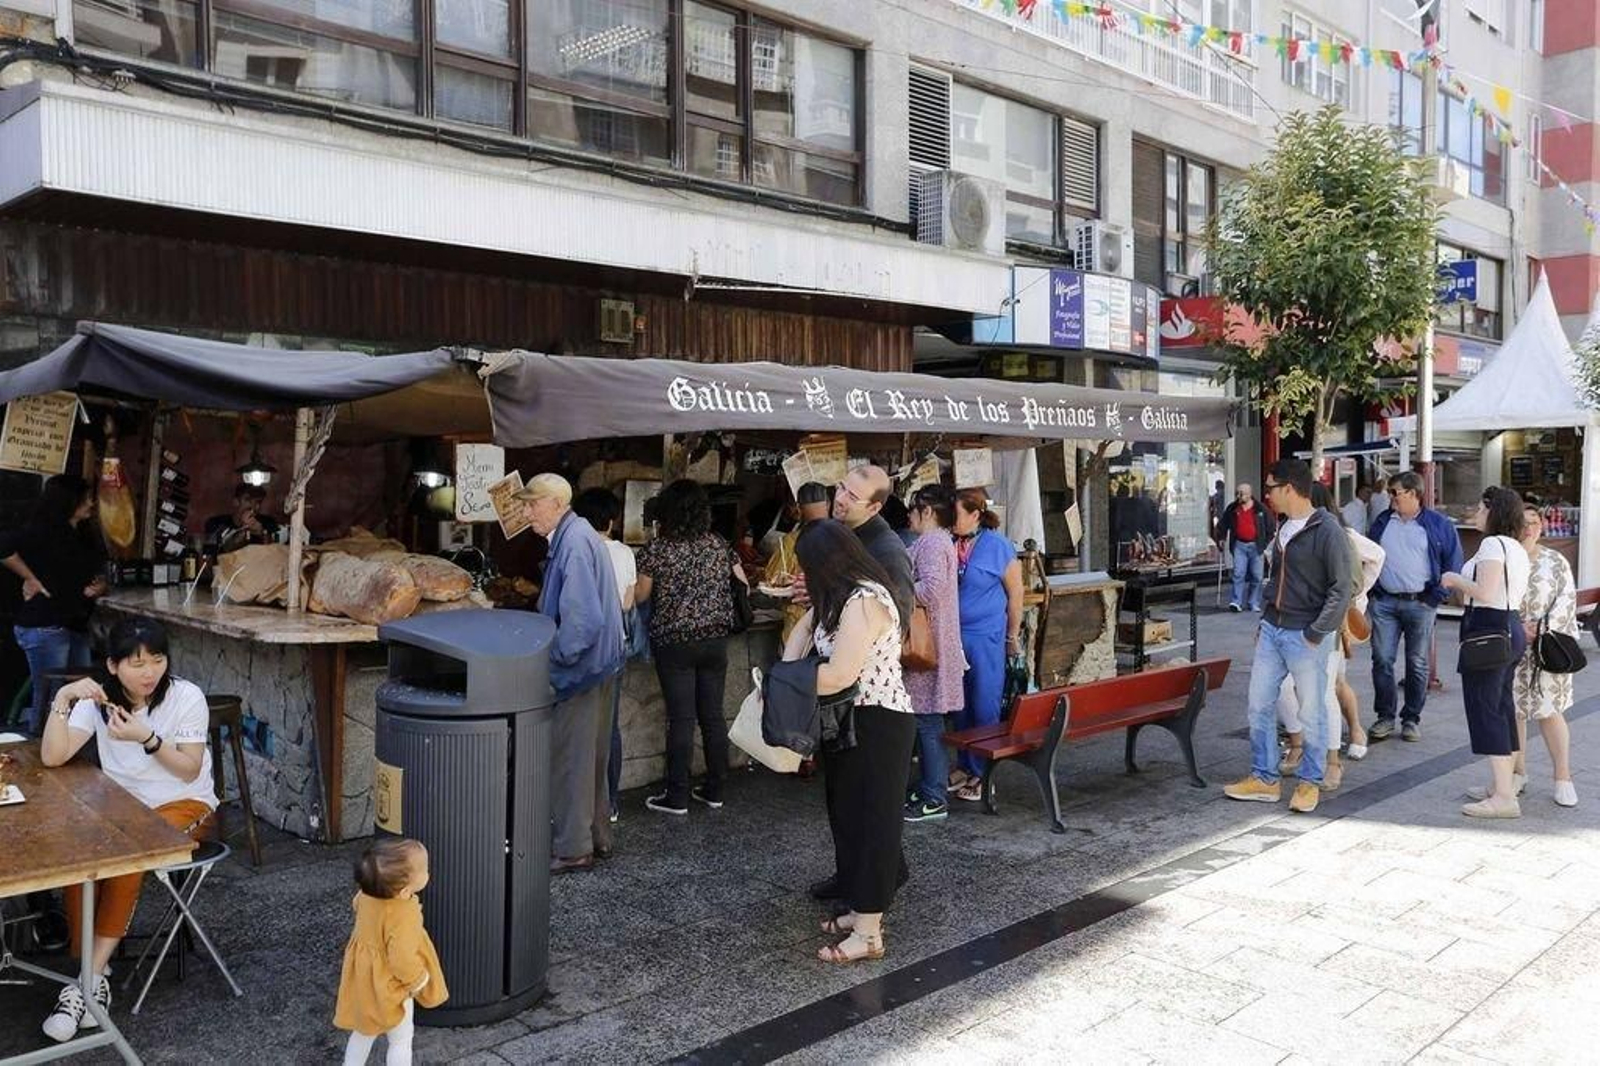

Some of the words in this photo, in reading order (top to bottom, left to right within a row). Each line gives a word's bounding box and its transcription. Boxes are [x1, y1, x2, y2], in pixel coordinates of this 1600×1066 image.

[667, 376, 775, 414] Galicia
[846, 387, 880, 420] El
[885, 389, 935, 427] Rey
[945, 395, 971, 422] de
[976, 394, 1011, 424] los
[1021, 396, 1096, 431] Preñaos
[1140, 405, 1188, 431] Galicia
